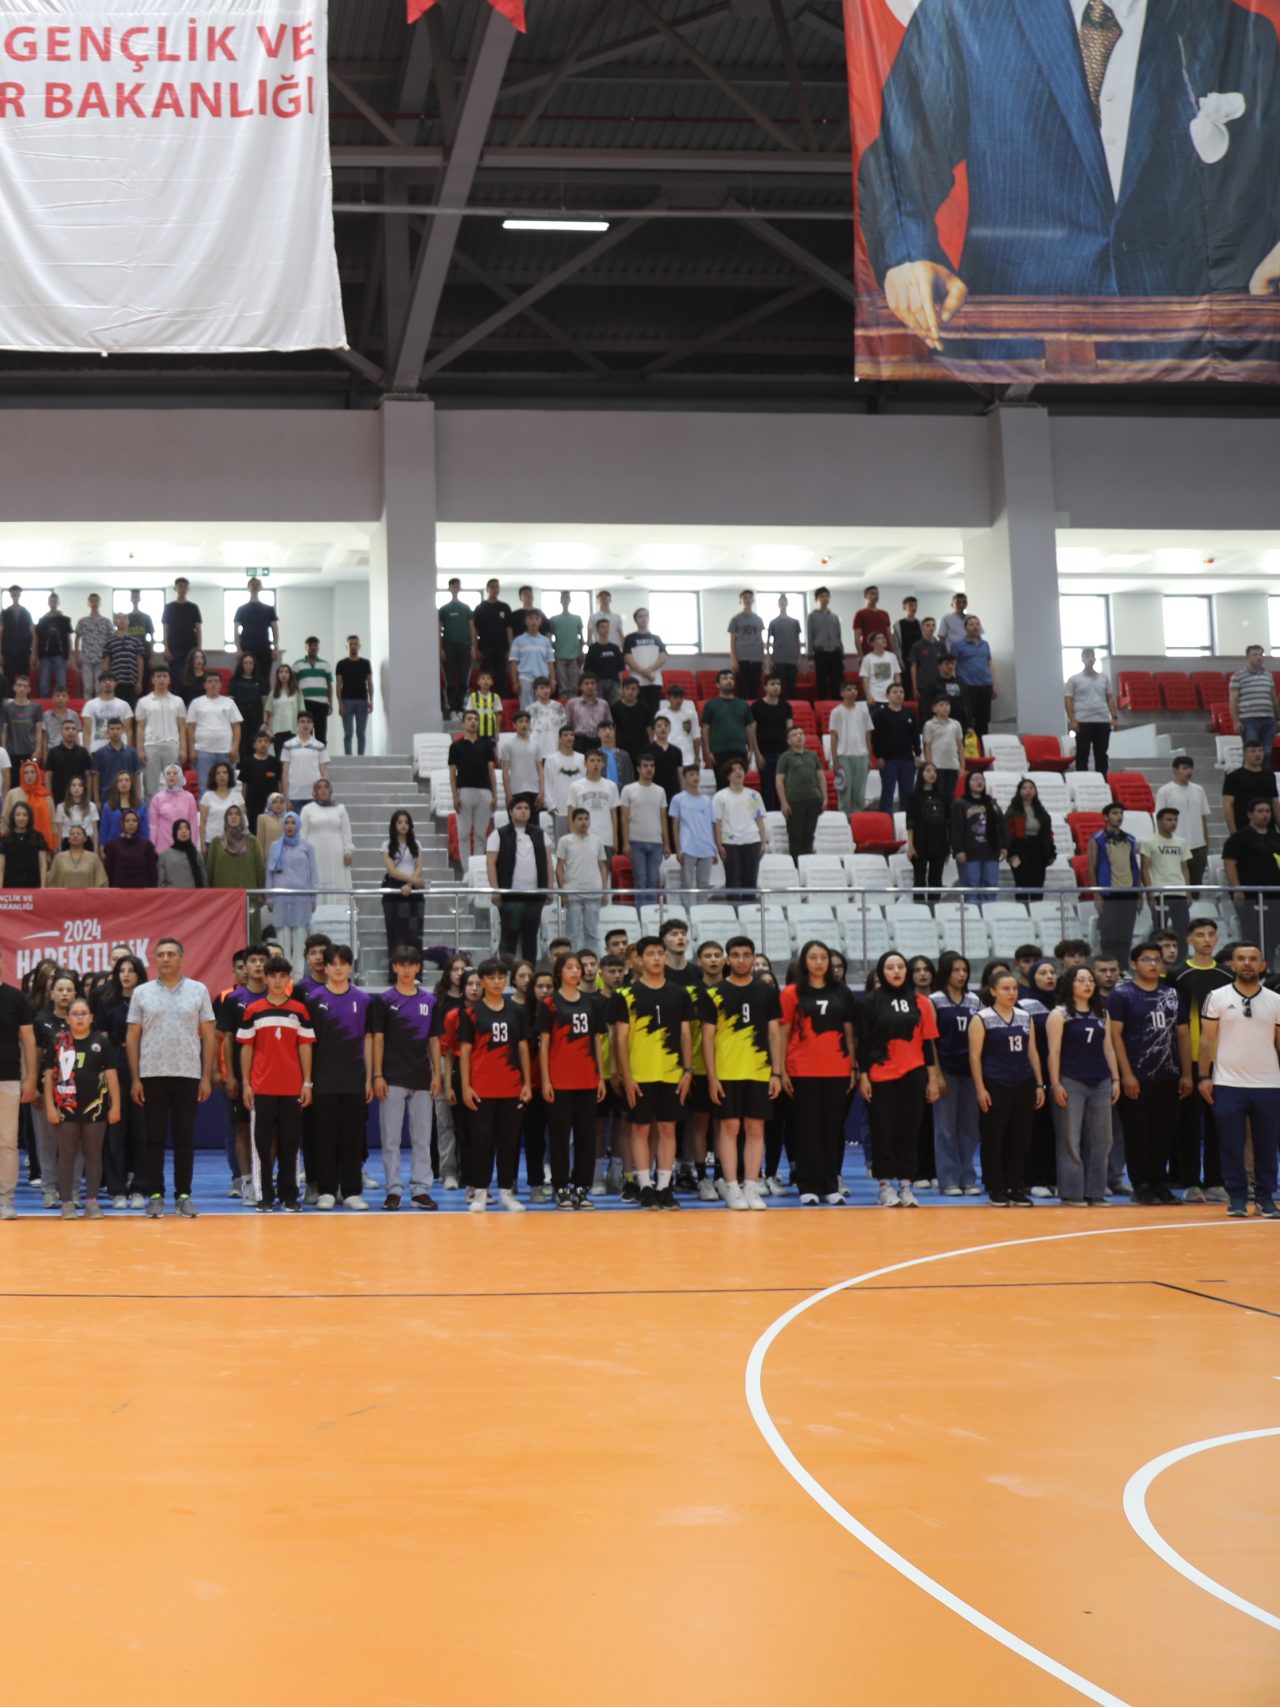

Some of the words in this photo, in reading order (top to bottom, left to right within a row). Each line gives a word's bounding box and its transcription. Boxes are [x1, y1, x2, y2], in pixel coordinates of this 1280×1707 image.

[4, 18, 237, 72] GENÇLİK
[256, 21, 316, 62] VE
[44, 74, 314, 119] BAKANLIĞI
[64, 919, 102, 943] 2024
[419, 1003, 429, 1016] 10
[742, 1003, 750, 1023] 9
[816, 1000, 828, 1015] 7
[891, 998, 910, 1014] 18
[572, 1013, 589, 1033] 53
[955, 1015, 967, 1031] 17
[1150, 1011, 1166, 1029] 10
[492, 1022, 508, 1042] 93
[1085, 1027, 1094, 1043] 7
[1008, 1035, 1022, 1052] 13
